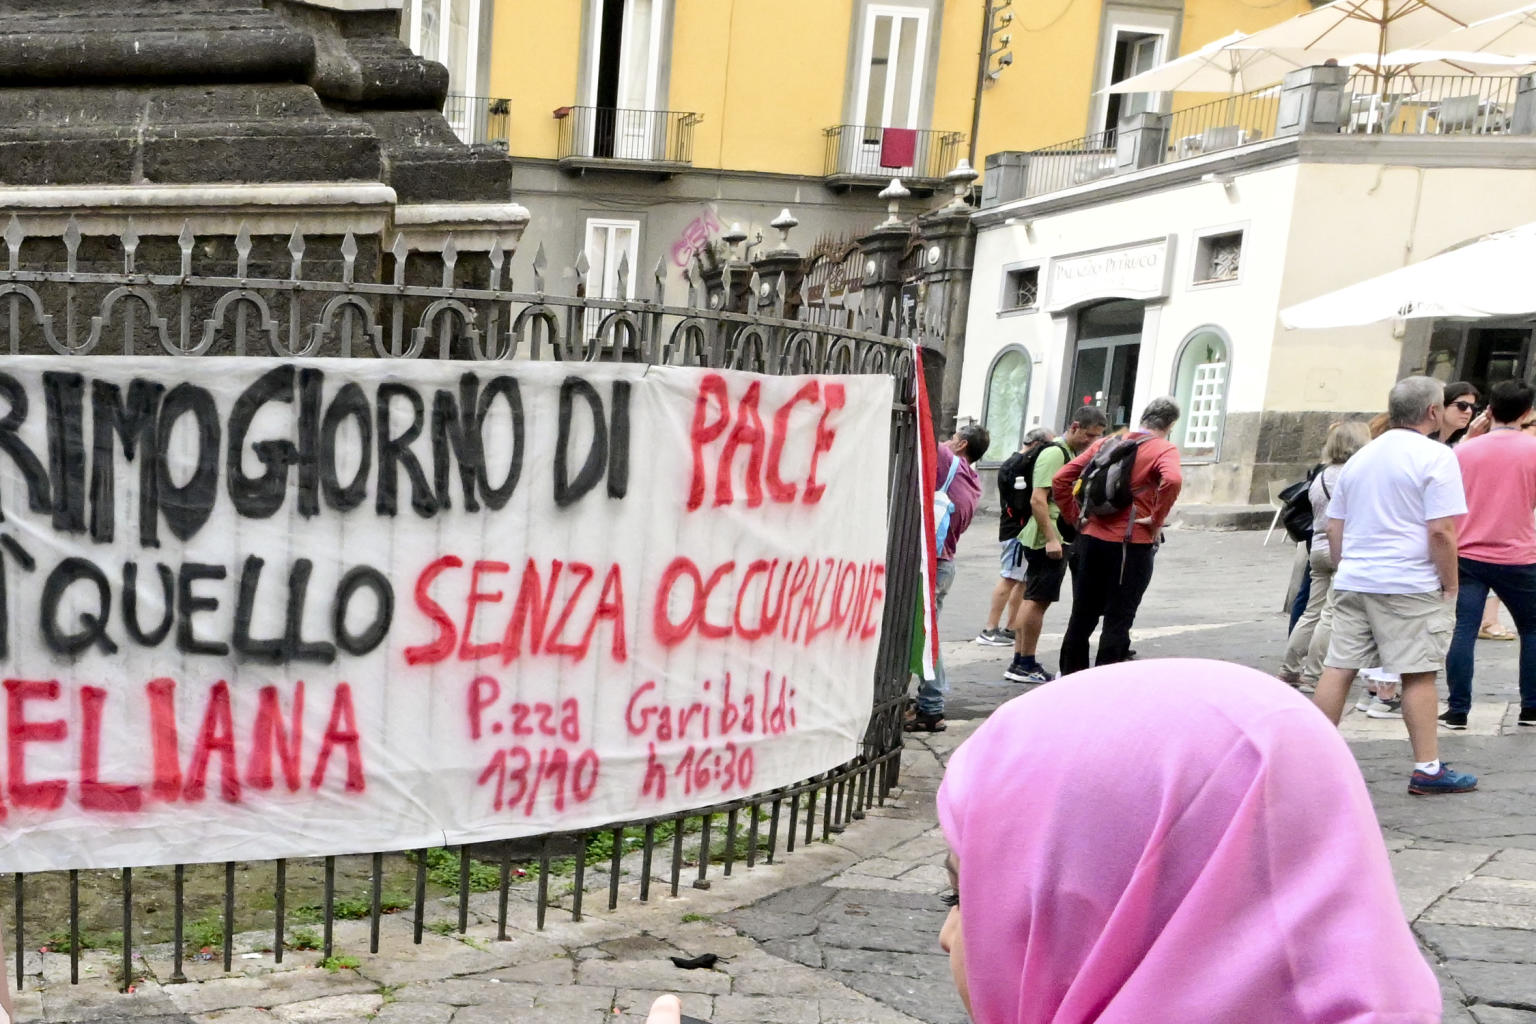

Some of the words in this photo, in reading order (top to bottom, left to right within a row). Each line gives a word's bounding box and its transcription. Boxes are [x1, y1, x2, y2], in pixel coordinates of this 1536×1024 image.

[227, 364, 524, 519] GIORNO
[553, 375, 631, 507] DI
[686, 373, 847, 512] PACE
[40, 554, 394, 665] QUELLO
[404, 554, 628, 666] SENZA
[654, 555, 886, 647] OCCUPAZIONE
[468, 675, 580, 742] P.zza
[625, 670, 796, 742] Garibaldi
[477, 746, 600, 817] 13/10
[675, 741, 755, 796] 16:30
